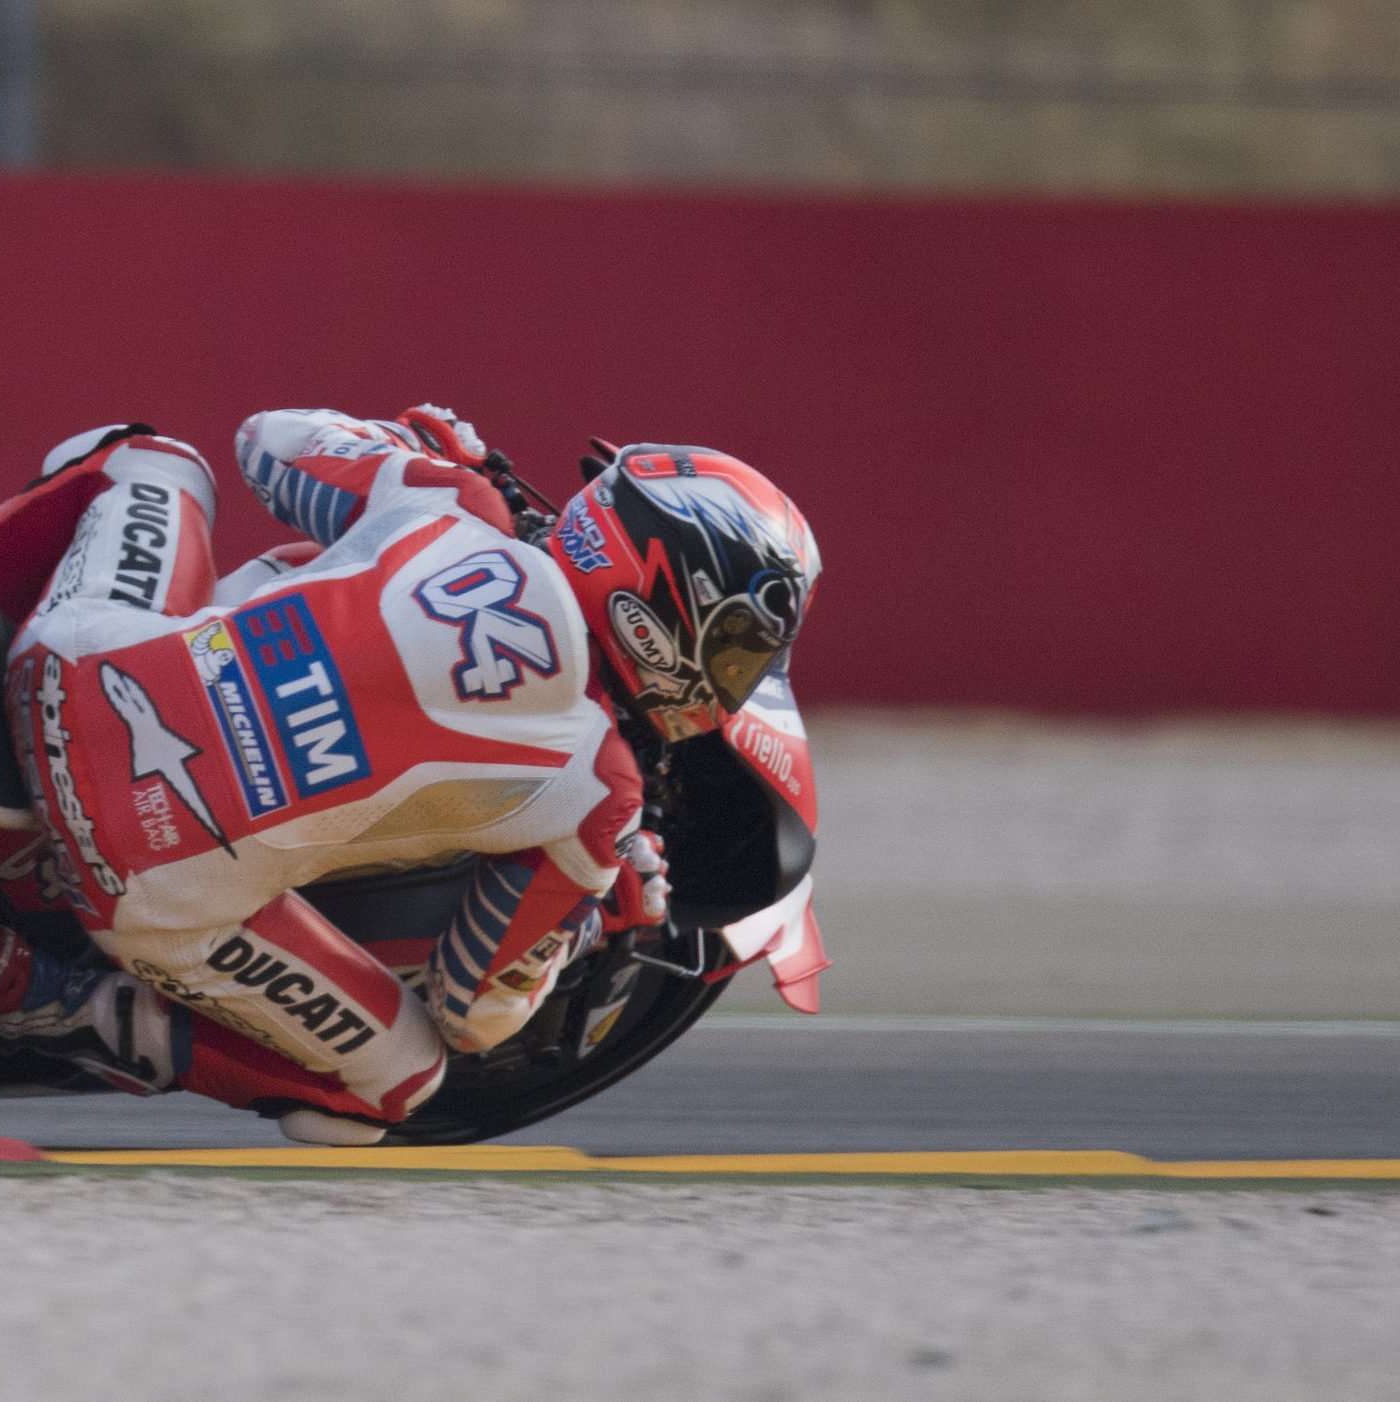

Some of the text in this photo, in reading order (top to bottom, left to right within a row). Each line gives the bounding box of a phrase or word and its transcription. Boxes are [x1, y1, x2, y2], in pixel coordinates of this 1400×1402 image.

[108, 482, 170, 610] DUCATI
[411, 549, 561, 702] 04
[620, 600, 669, 668] SUOMY
[36, 652, 128, 897] alpinestars
[219, 681, 278, 807] MICHELIN
[275, 660, 359, 785] TIM
[744, 723, 793, 782] riello
[132, 790, 164, 851] AIR BAG
[206, 935, 378, 1056] DUCATI
